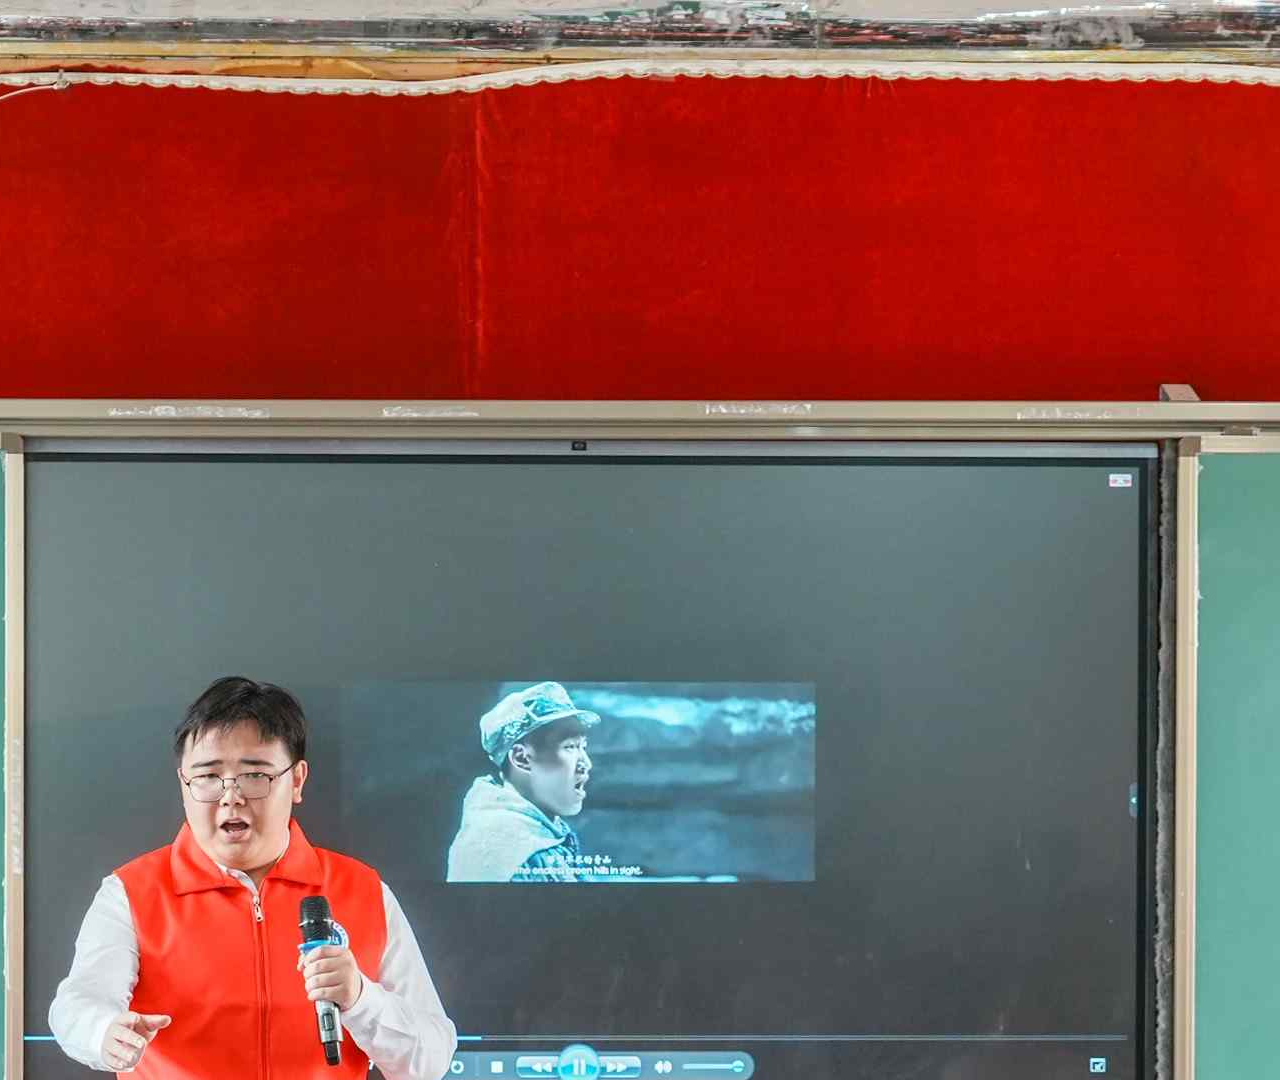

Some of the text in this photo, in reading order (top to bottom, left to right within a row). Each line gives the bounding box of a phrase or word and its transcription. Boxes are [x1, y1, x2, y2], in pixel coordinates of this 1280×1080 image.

[567, 867, 593, 877] green
[594, 866, 609, 875] hills
[610, 866, 618, 875] in
